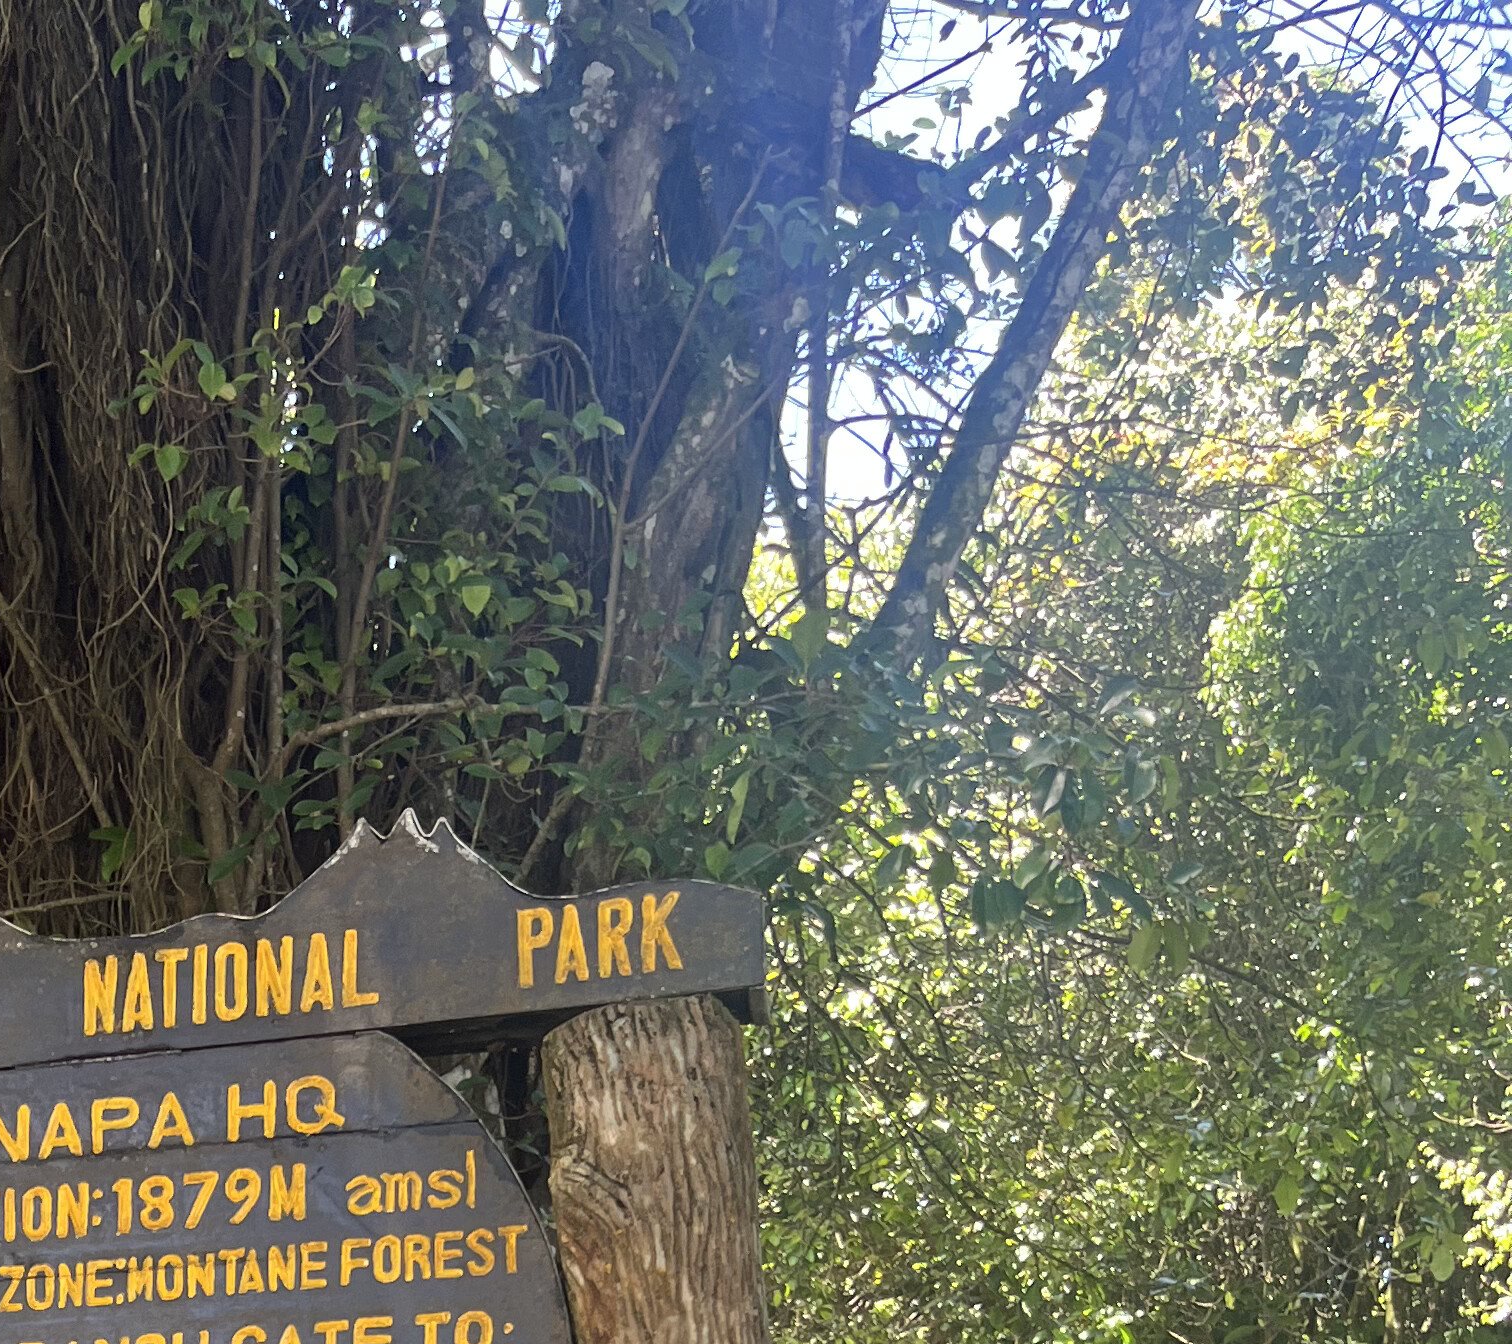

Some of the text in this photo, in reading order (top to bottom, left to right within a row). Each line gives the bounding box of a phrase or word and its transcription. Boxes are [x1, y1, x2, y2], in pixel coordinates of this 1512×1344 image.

[83, 929, 380, 1037] NATIONAL
[516, 892, 682, 988] PARK
[226, 1074, 346, 1150] HQ
[346, 1151, 477, 1216] amsl
[339, 1224, 529, 1290] FOREST
